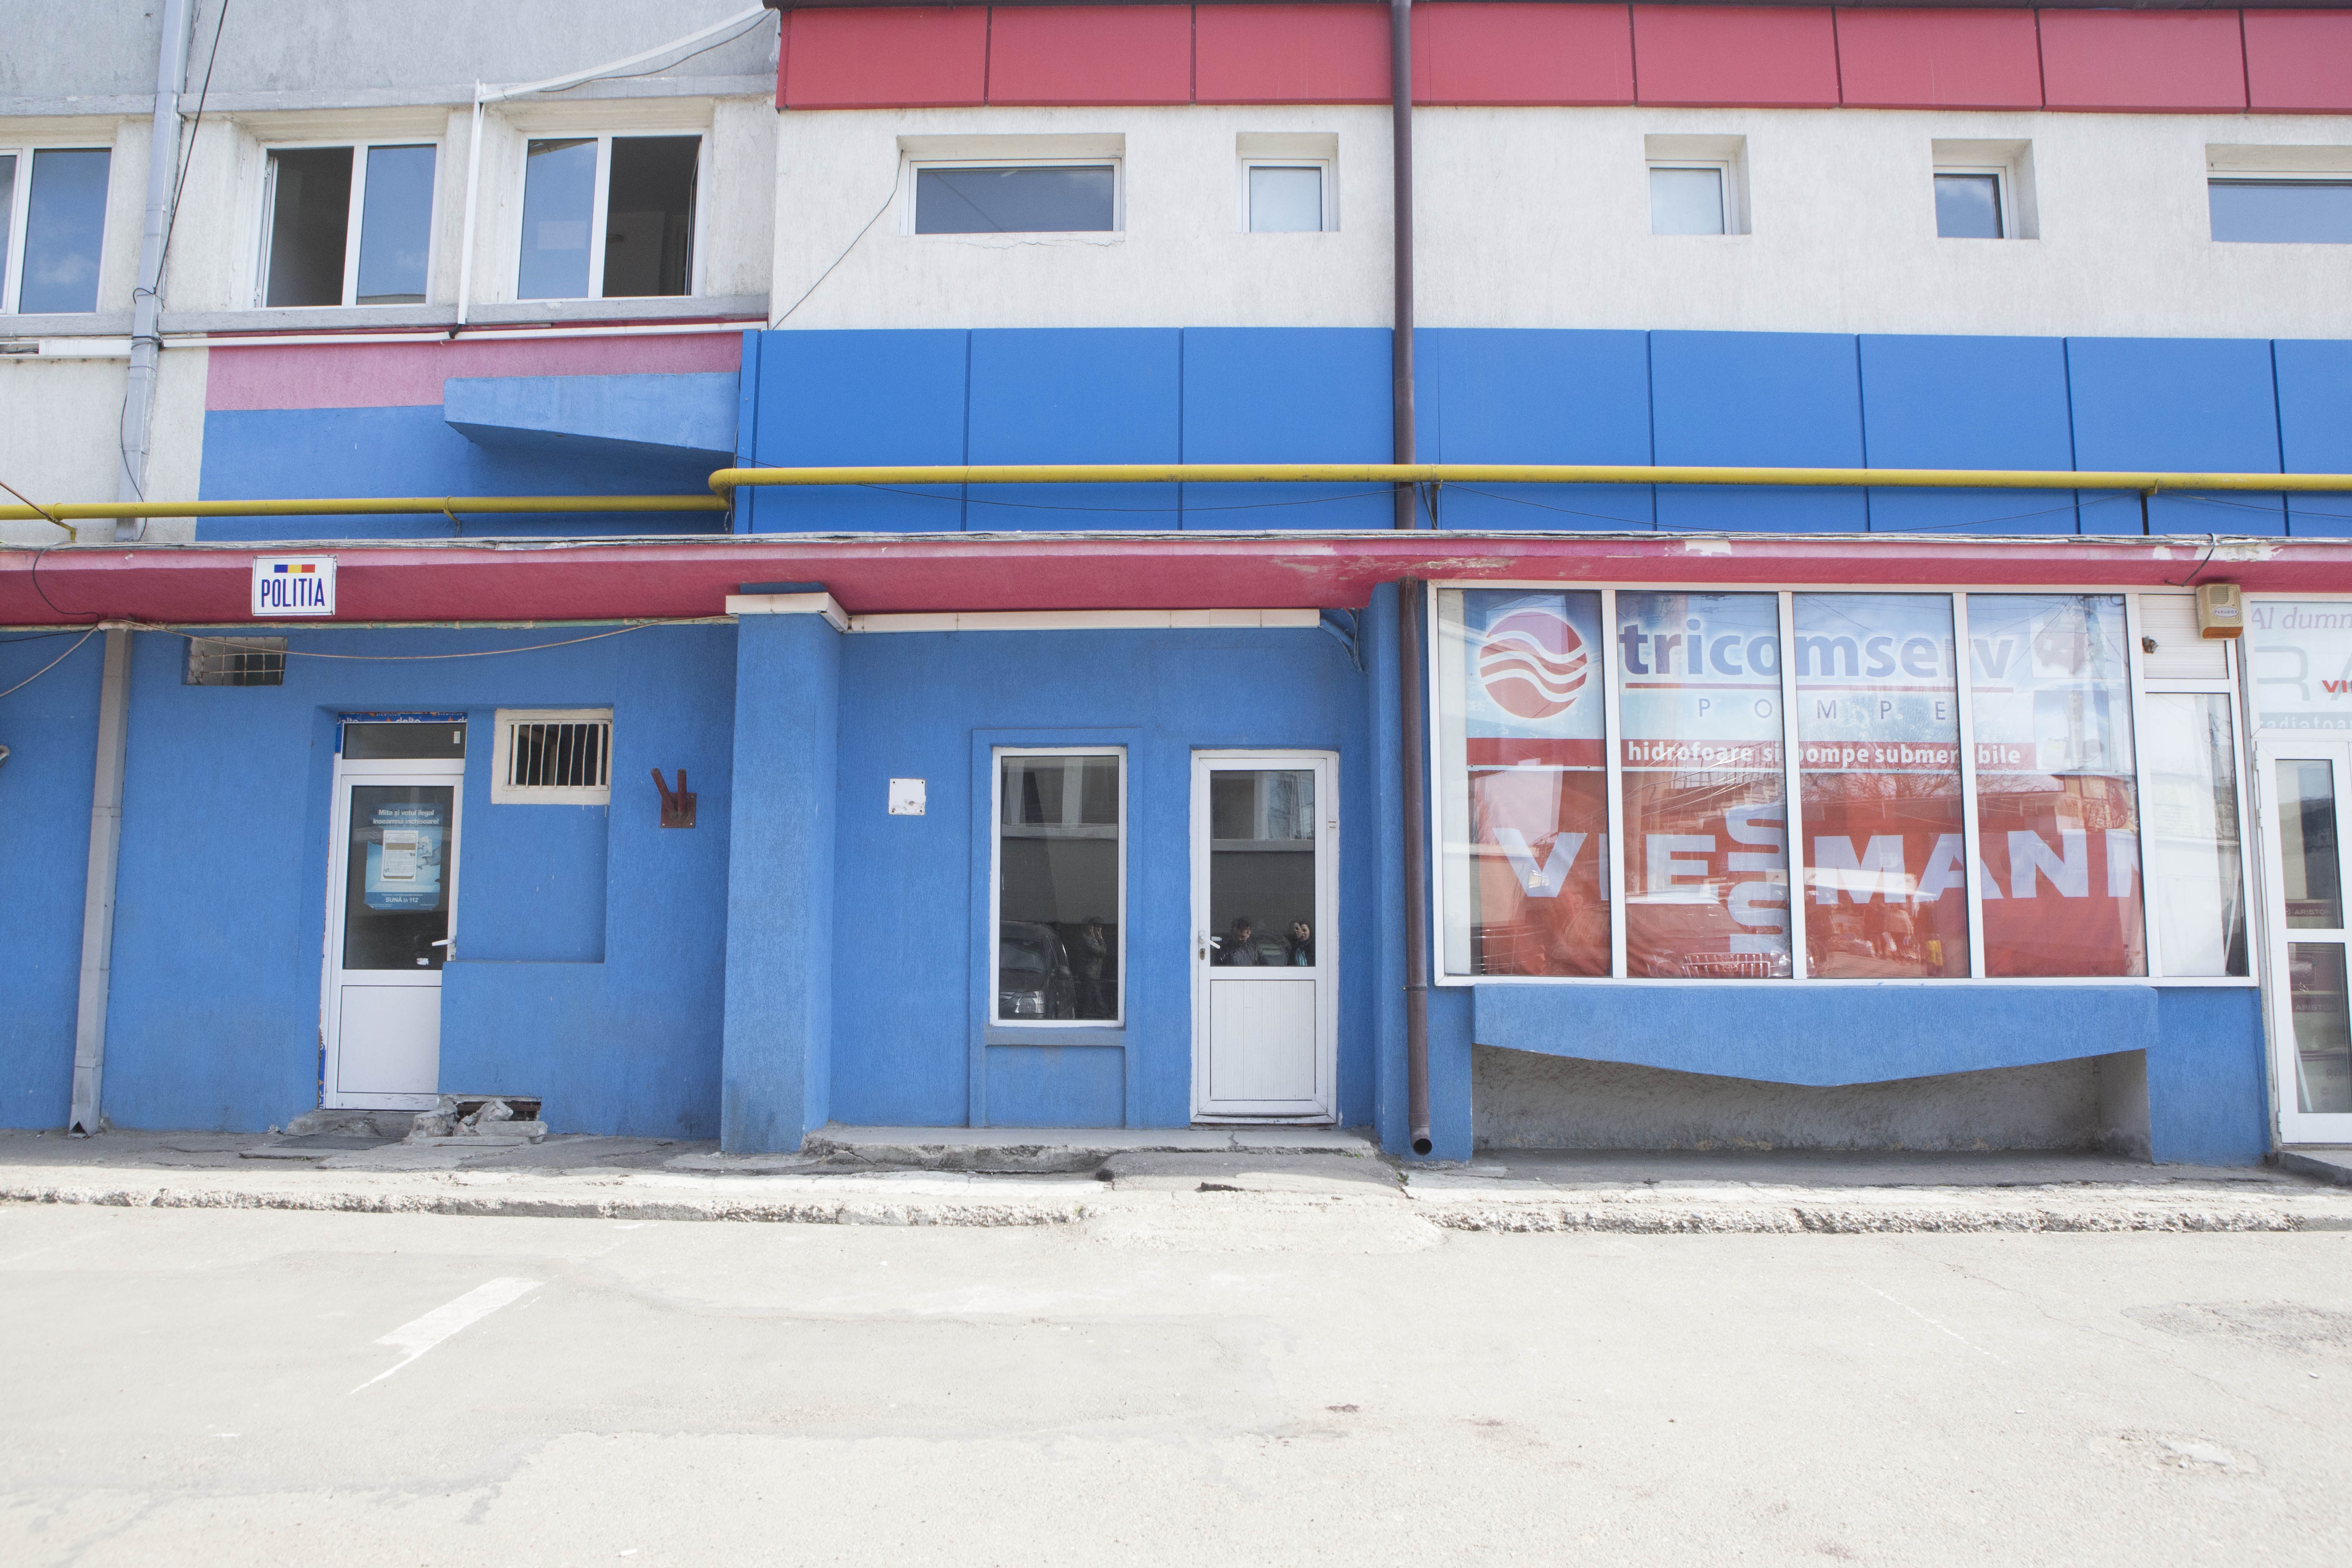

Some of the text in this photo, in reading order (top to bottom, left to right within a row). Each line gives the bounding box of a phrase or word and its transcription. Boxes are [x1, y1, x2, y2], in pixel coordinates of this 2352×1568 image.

[261, 578, 325, 607] POLITIA
[2321, 680, 2352, 693] VI
[1628, 741, 1752, 762] hidrofoare
[1763, 743, 1779, 762] si
[1799, 747, 1869, 768] ompe
